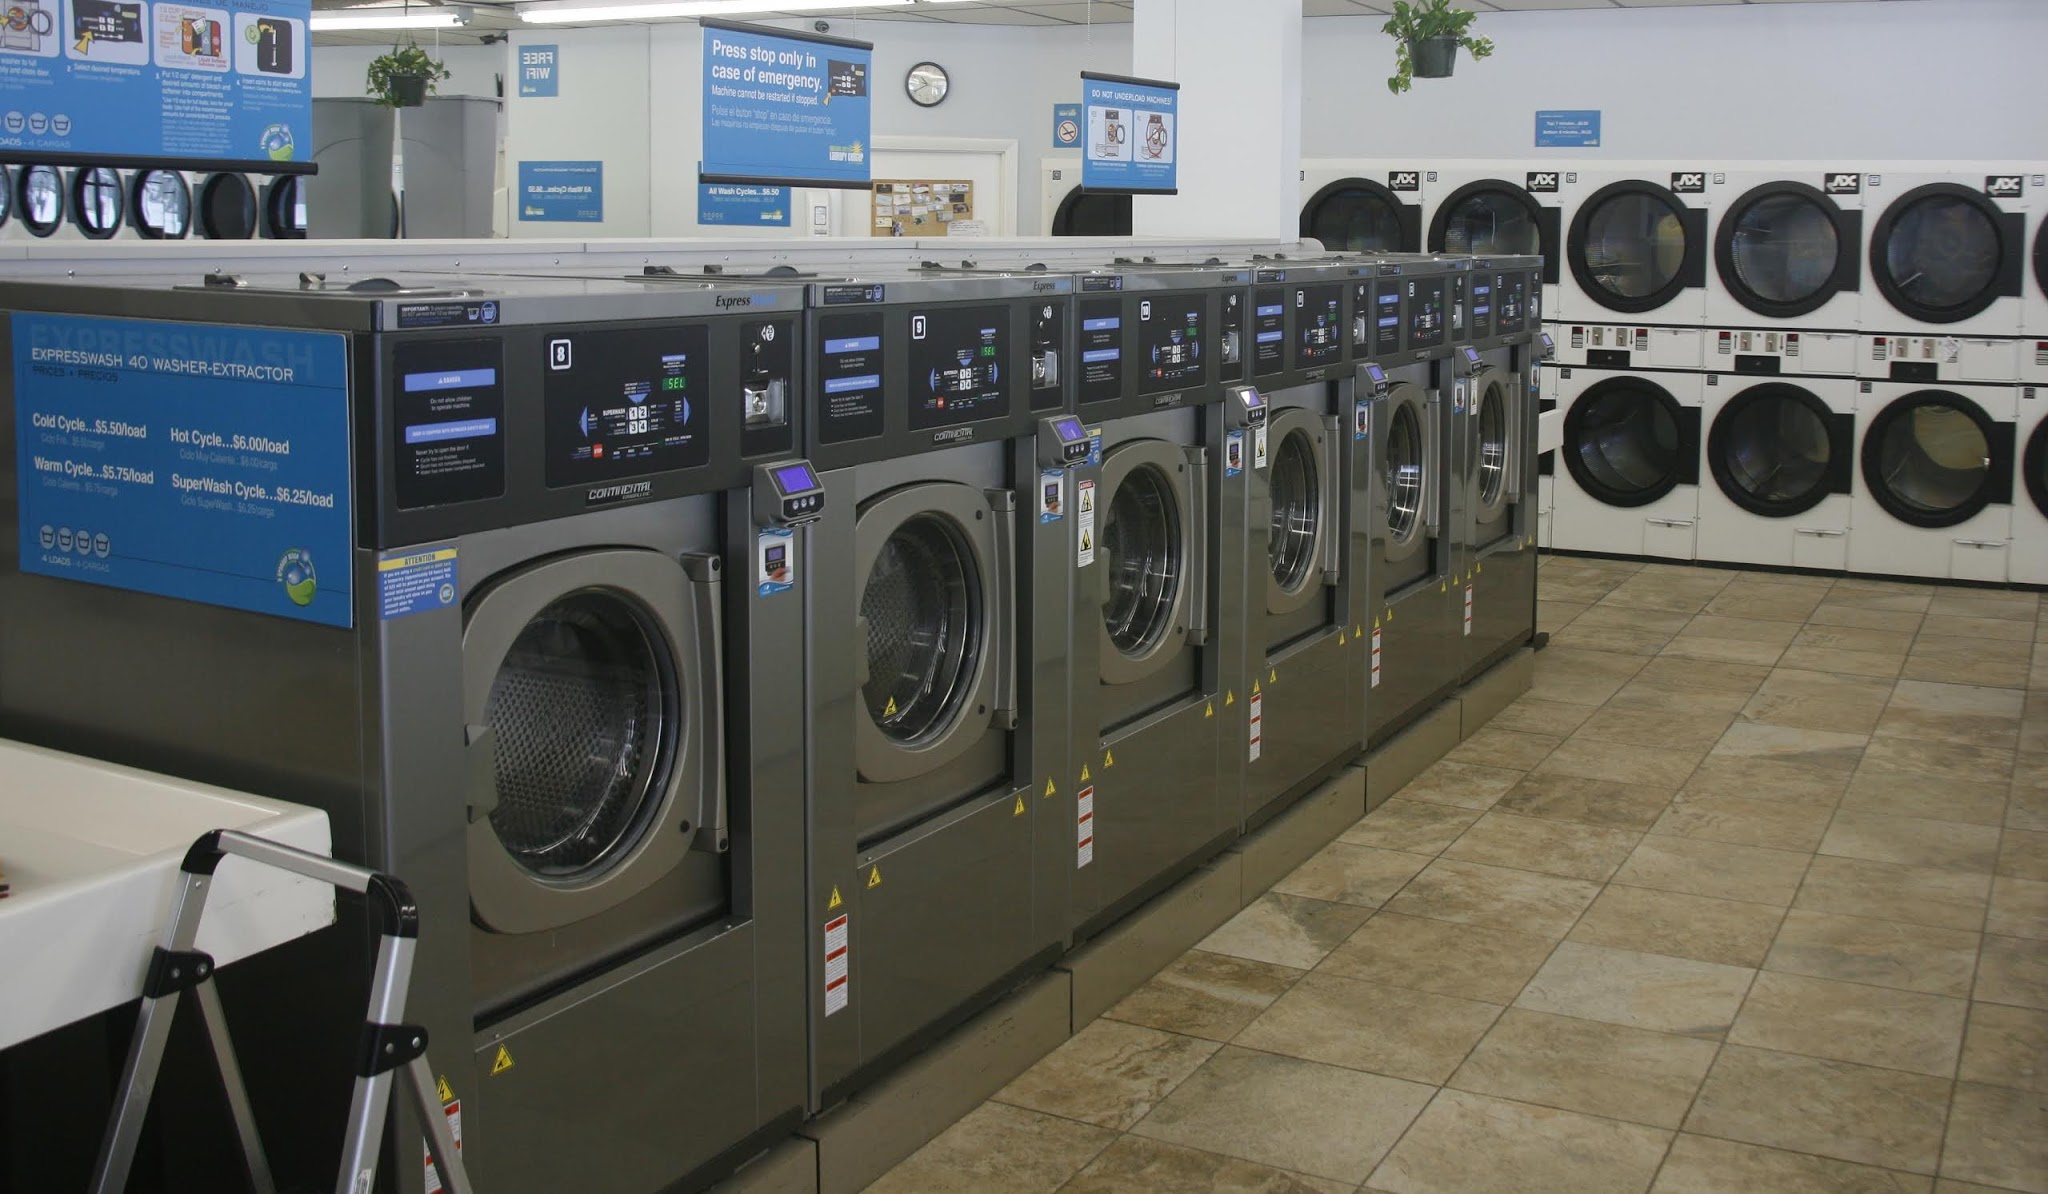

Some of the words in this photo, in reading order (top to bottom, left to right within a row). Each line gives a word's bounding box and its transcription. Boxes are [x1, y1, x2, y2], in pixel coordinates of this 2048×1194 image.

[712, 39, 747, 60] Press
[750, 46, 776, 69] stop
[778, 51, 803, 70] only
[806, 54, 816, 68] in
[712, 66, 741, 81] case
[743, 66, 756, 82] of
[758, 71, 822, 93] emergency.
[711, 85, 737, 98] Machine
[737, 90, 757, 100] cannot
[758, 91, 765, 100] be
[766, 92, 791, 103] restarted
[791, 93, 796, 102] if
[796, 94, 818, 107] stopped.
[1091, 89, 1101, 98] DO
[1101, 90, 1113, 99] NOT
[1114, 92, 1145, 103] UNDERLOAD
[711, 104, 728, 116] Pulse
[728, 105, 735, 116] el
[770, 111, 777, 120] en
[779, 111, 792, 121] caso
[792, 112, 800, 121] de
[0, 137, 22, 146] OADS
[1396, 173, 1416, 184] ADC
[1534, 174, 1556, 185] ADC
[1679, 173, 1702, 186] ADC
[1833, 174, 1857, 187] ADC
[1994, 177, 2021, 190] ADC
[708, 187, 717, 195] All
[717, 187, 735, 196] Wash
[715, 295, 751, 311] Express
[916, 321, 922, 334] 9
[557, 346, 566, 362] 8
[32, 347, 123, 367] EXPRESSWASH
[129, 355, 148, 369] 40
[153, 357, 294, 382] WASHER-EXTRACTOR
[77, 369, 119, 383] PRECIOS
[668, 377, 685, 389] SEL
[33, 412, 56, 428] Cold
[170, 427, 189, 444] Hot
[34, 455, 63, 473] Warm
[172, 473, 233, 495] SuperWash
[588, 481, 651, 500] CONTINENTAL
[48, 555, 72, 566] LOADS
[404, 553, 436, 566] ATTENTION
